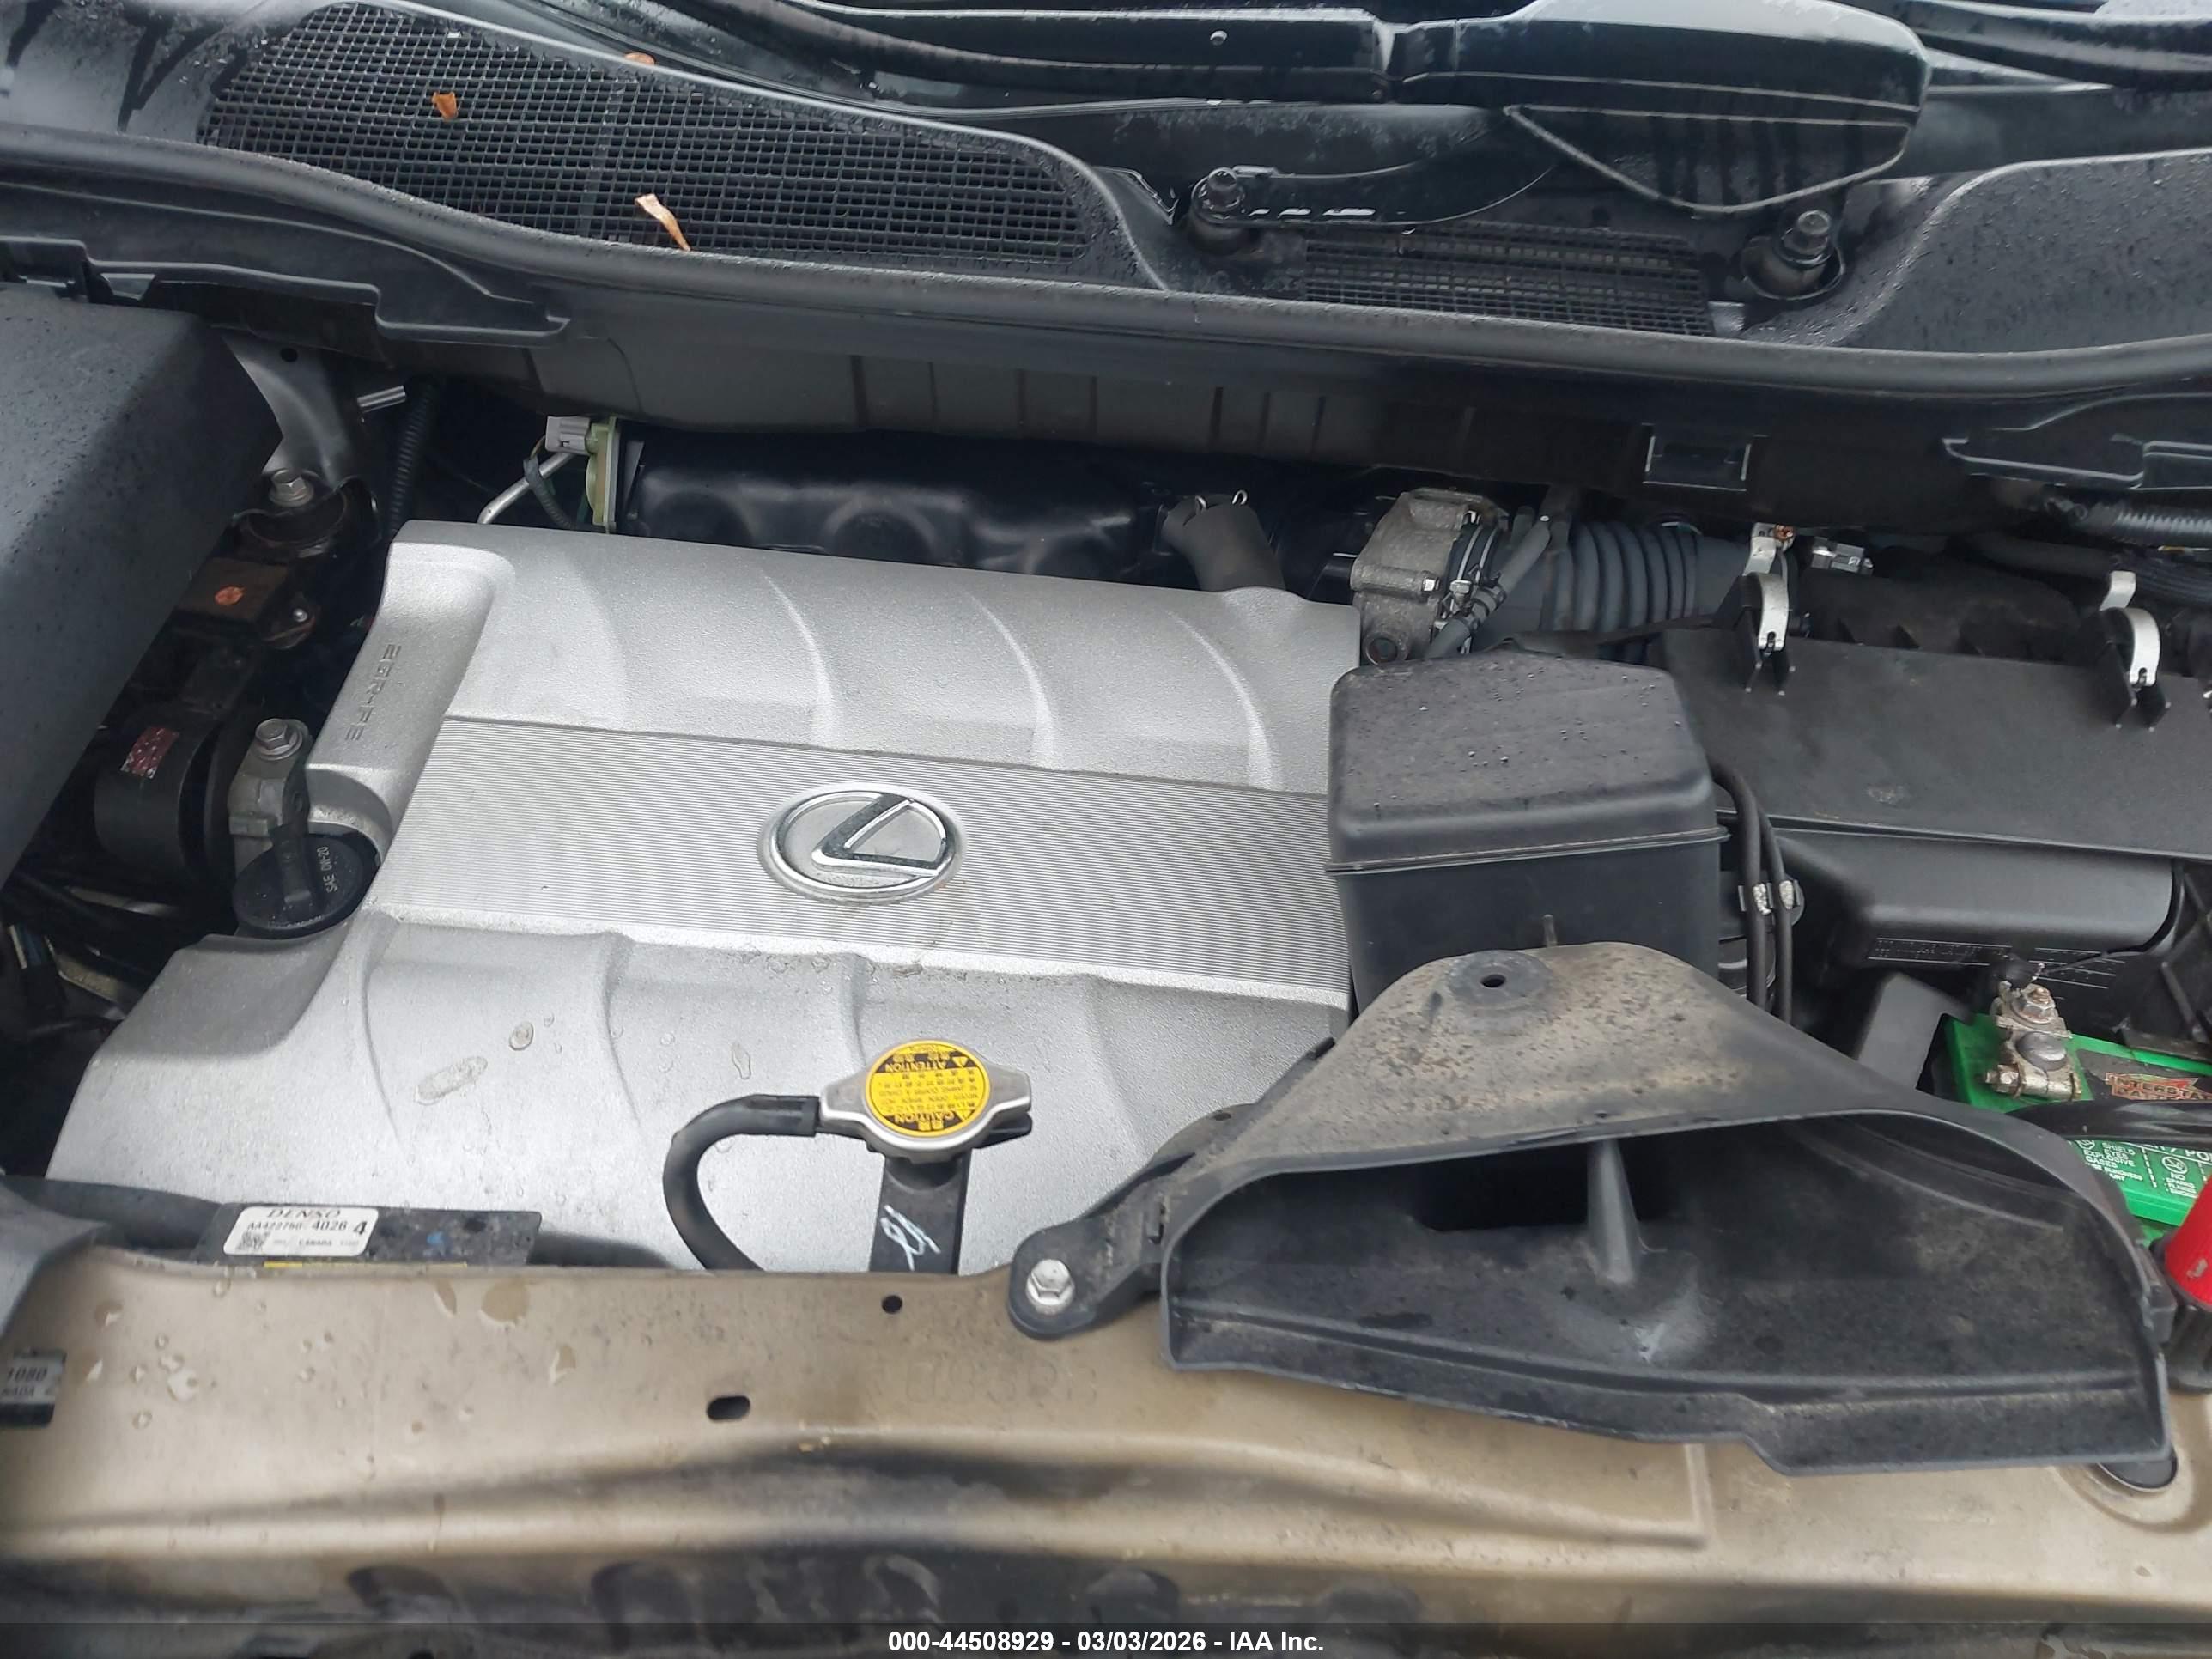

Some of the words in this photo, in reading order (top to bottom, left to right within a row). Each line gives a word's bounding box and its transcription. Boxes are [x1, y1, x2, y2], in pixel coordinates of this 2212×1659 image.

[323, 874, 338, 893] SAE
[884, 1060, 946, 1073] ATTENTION
[895, 1111, 955, 1123] CAUTION
[2101, 1142, 2136, 1156] SHIELD
[2104, 1148, 2129, 1160] EYES
[2184, 1148, 2212, 1163] PO
[2083, 1149, 2136, 1167] EXPLOSIVE
[2085, 1155, 2118, 1169] GASES
[267, 1209, 342, 1218] DENSO
[353, 1219, 368, 1236] 4
